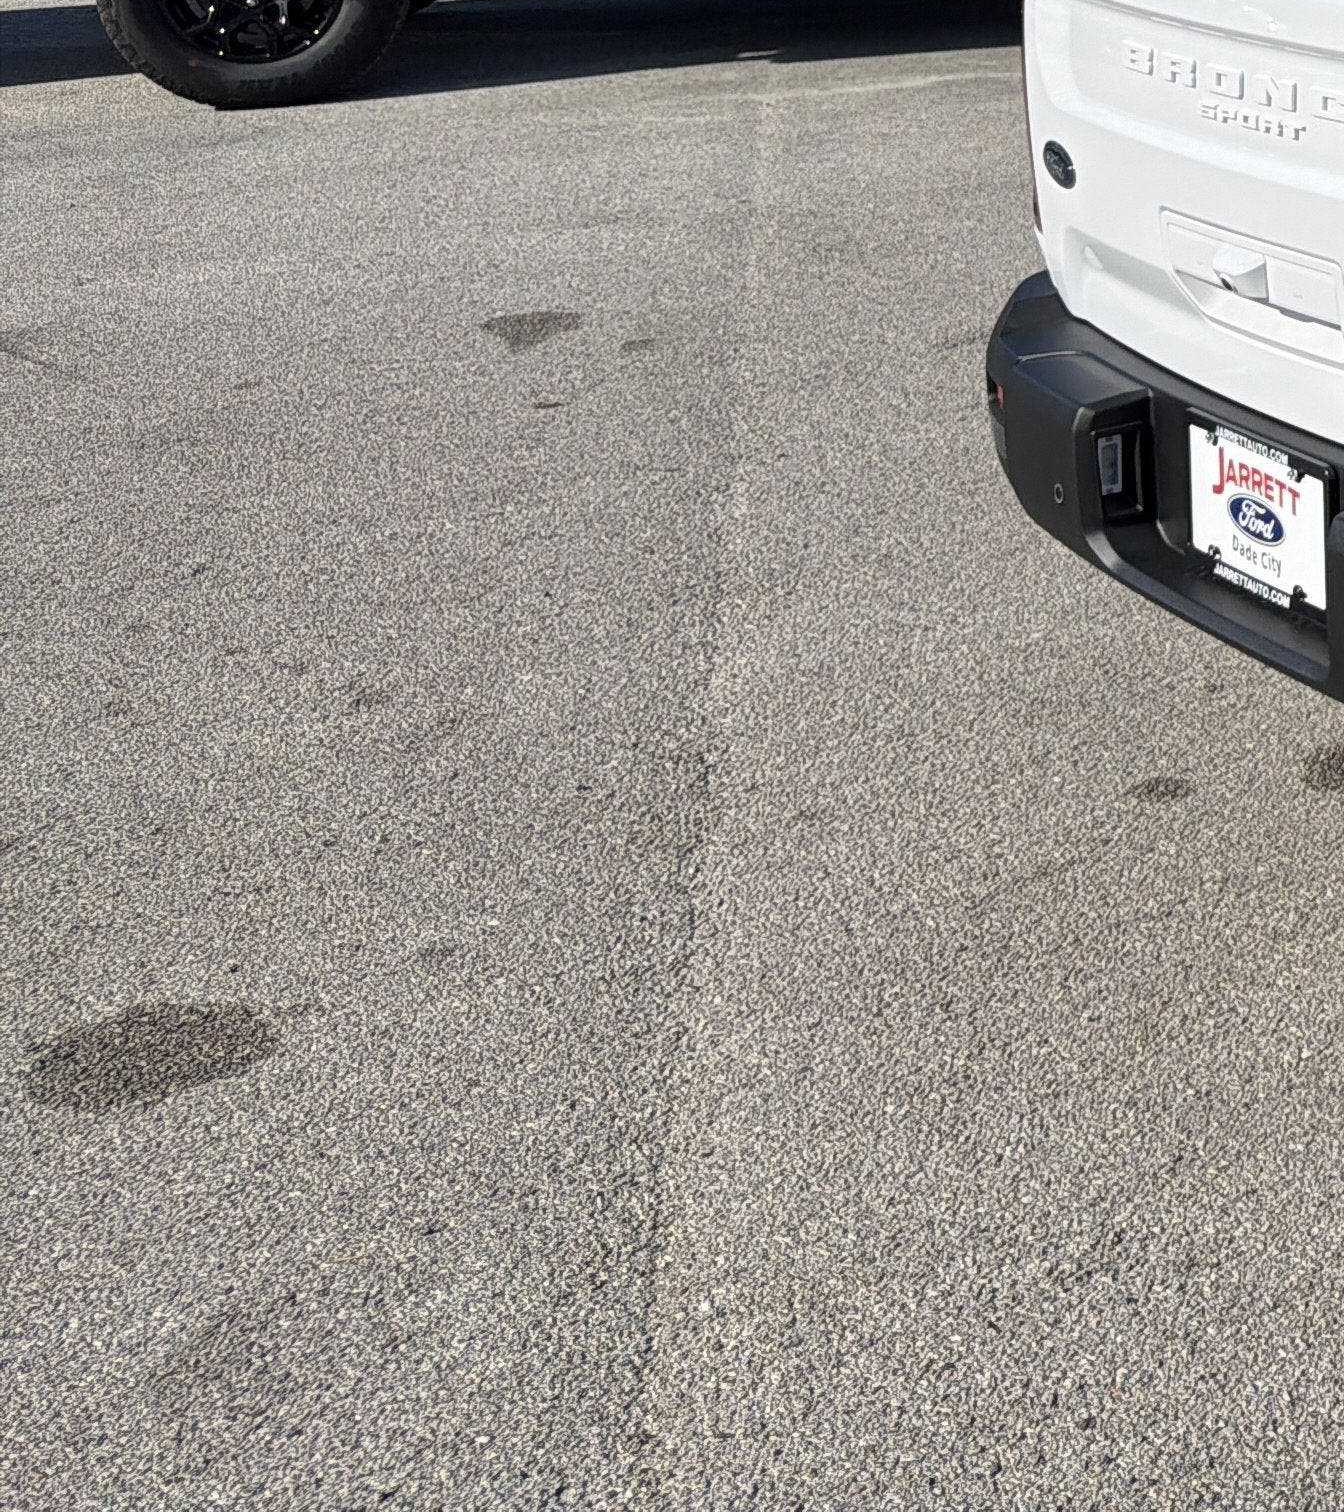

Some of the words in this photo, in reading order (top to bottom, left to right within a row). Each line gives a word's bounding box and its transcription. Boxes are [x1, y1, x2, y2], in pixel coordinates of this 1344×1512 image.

[1199, 103, 1307, 141] SPORT
[1215, 424, 1289, 467] JARRETTAUTO.COM
[1212, 446, 1300, 516] JARRETT
[1238, 498, 1275, 540] Ford
[1232, 534, 1258, 565] Dade
[1260, 551, 1282, 578] City
[1214, 562, 1290, 610] JARRETTAUTO.COM
